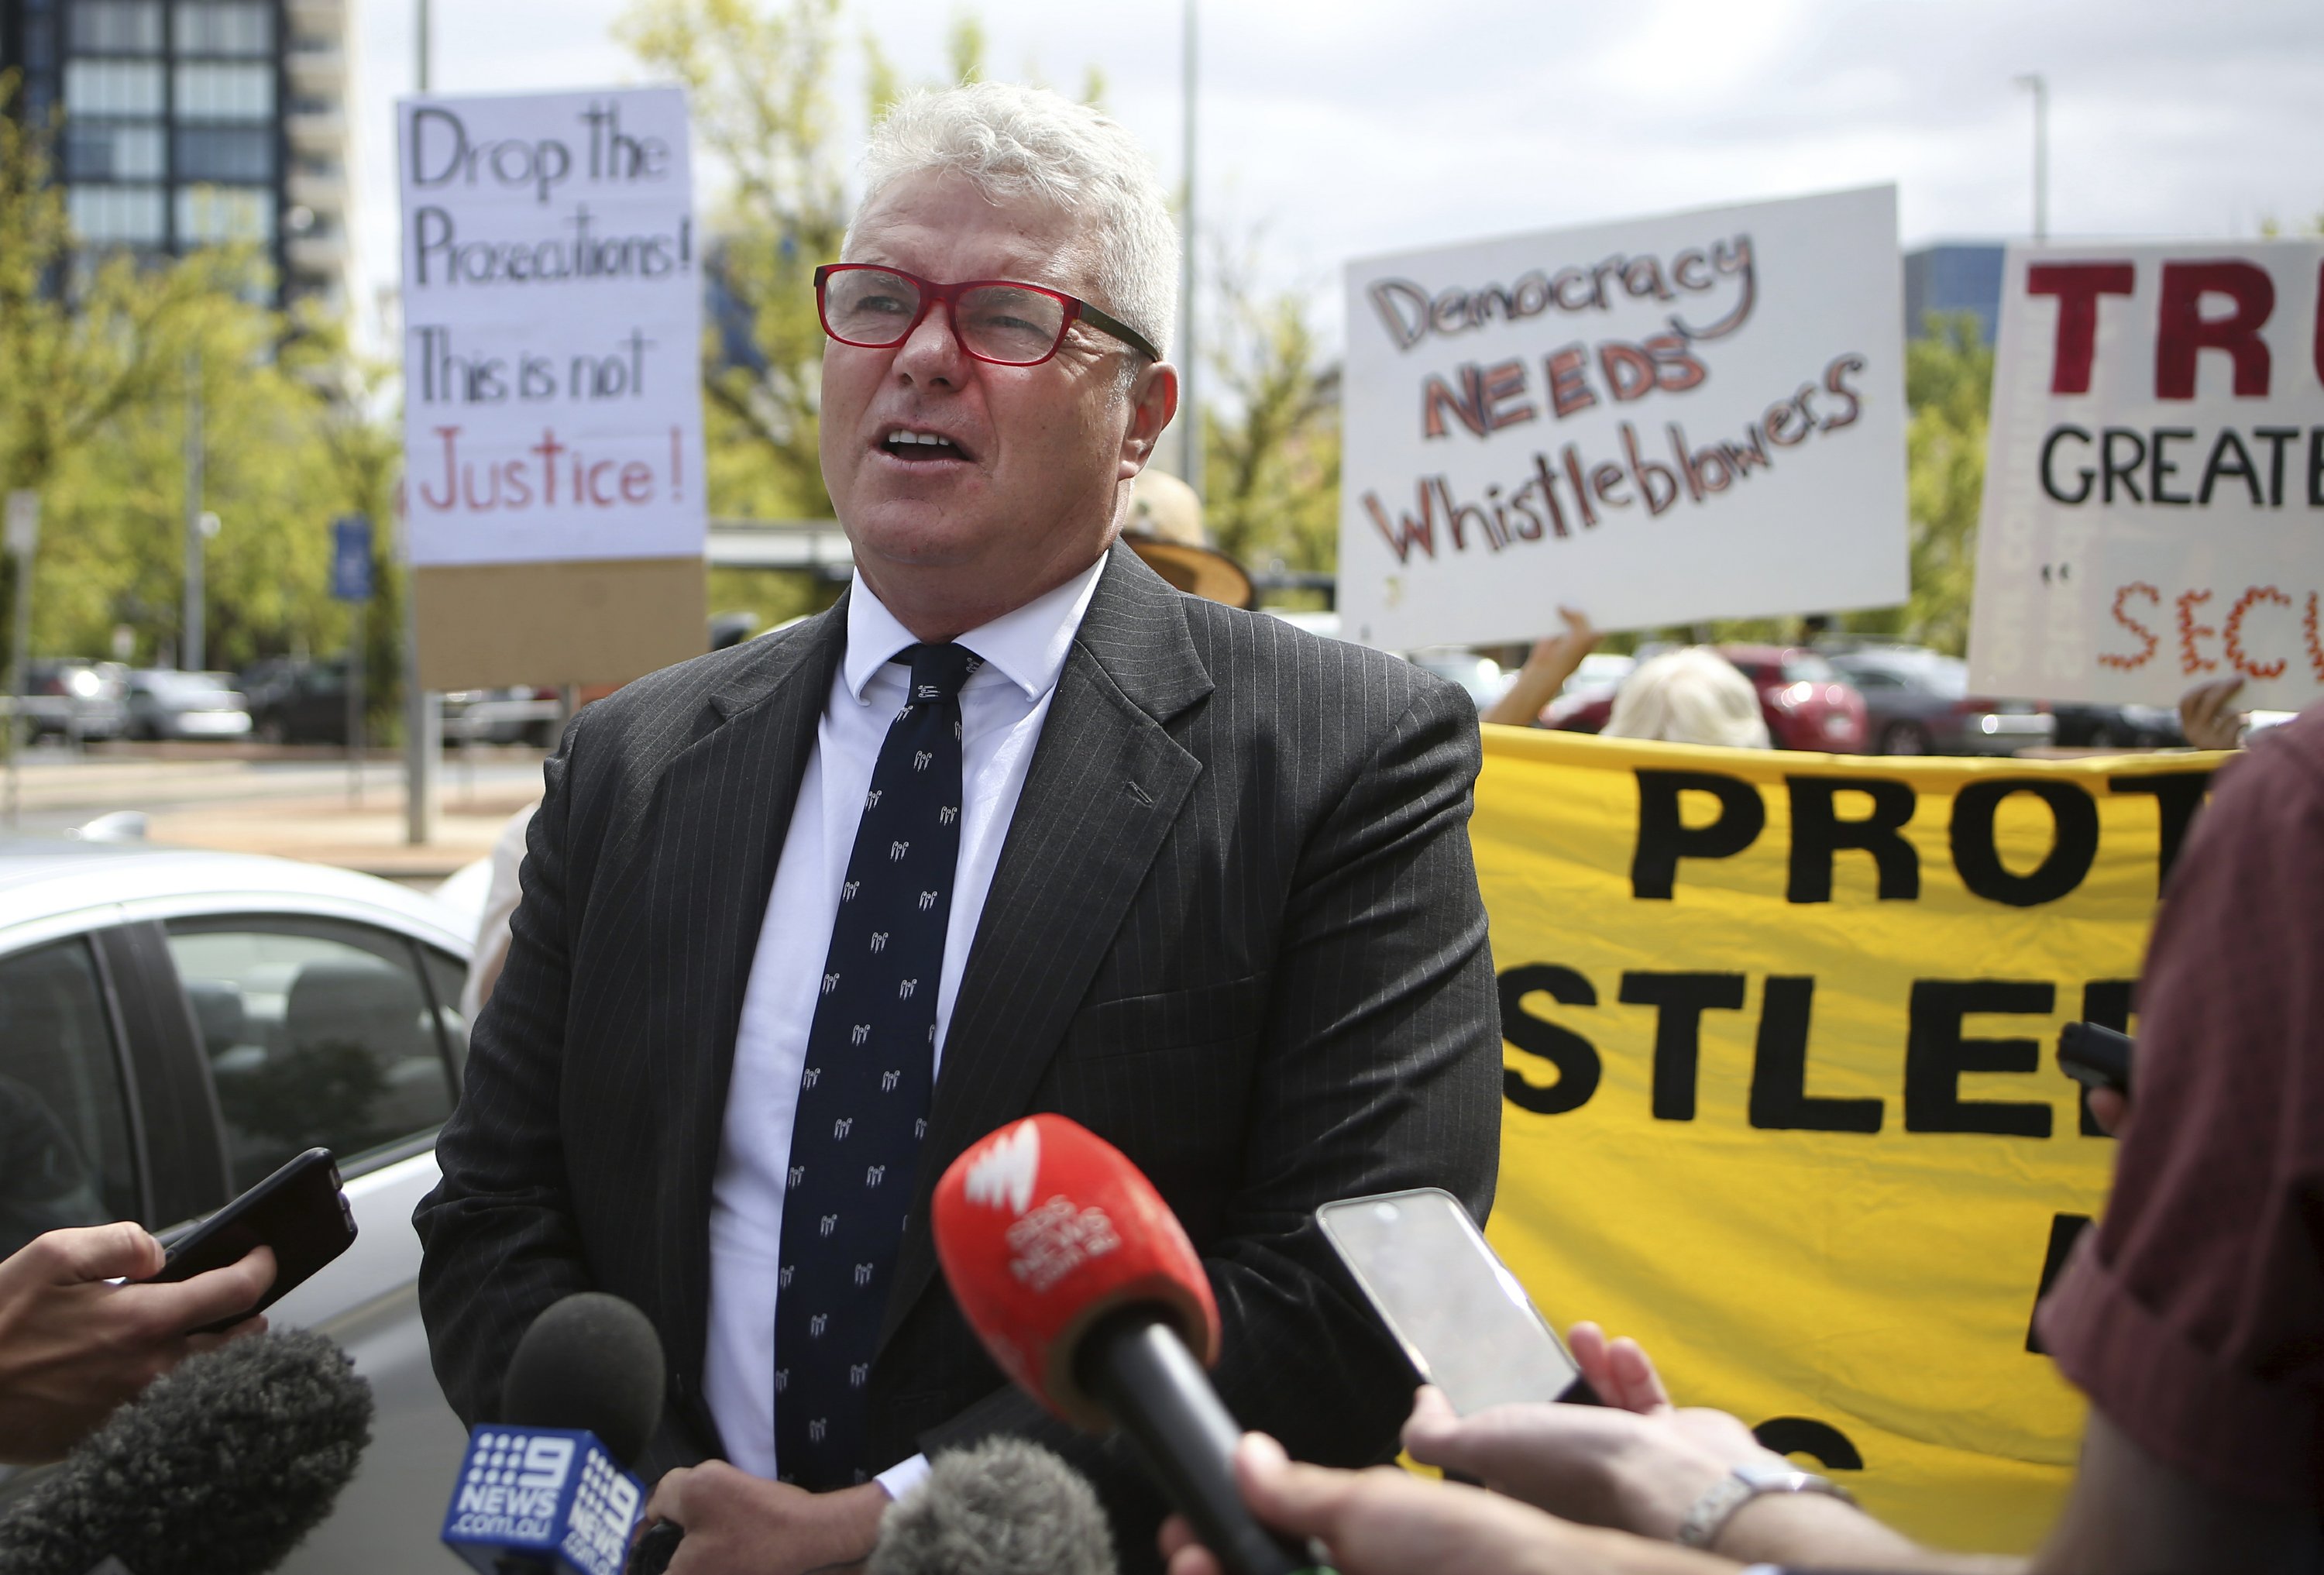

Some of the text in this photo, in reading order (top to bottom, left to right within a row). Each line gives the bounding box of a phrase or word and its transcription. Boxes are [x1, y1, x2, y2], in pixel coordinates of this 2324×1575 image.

[411, 99, 670, 205] Drop the
[413, 202, 691, 287] Prosecutions!
[1367, 232, 1758, 350] Democracy
[2027, 259, 2324, 400] TR
[411, 325, 658, 404] This is not
[1421, 335, 1708, 440] NEEDS
[420, 425, 684, 512] Justice!
[1360, 352, 1868, 566] Whistleblowers
[457, 1484, 559, 1518] NEWS
[517, 1436, 575, 1490] 9
[601, 1470, 640, 1539] 9
[450, 1513, 555, 1541] .com.au
